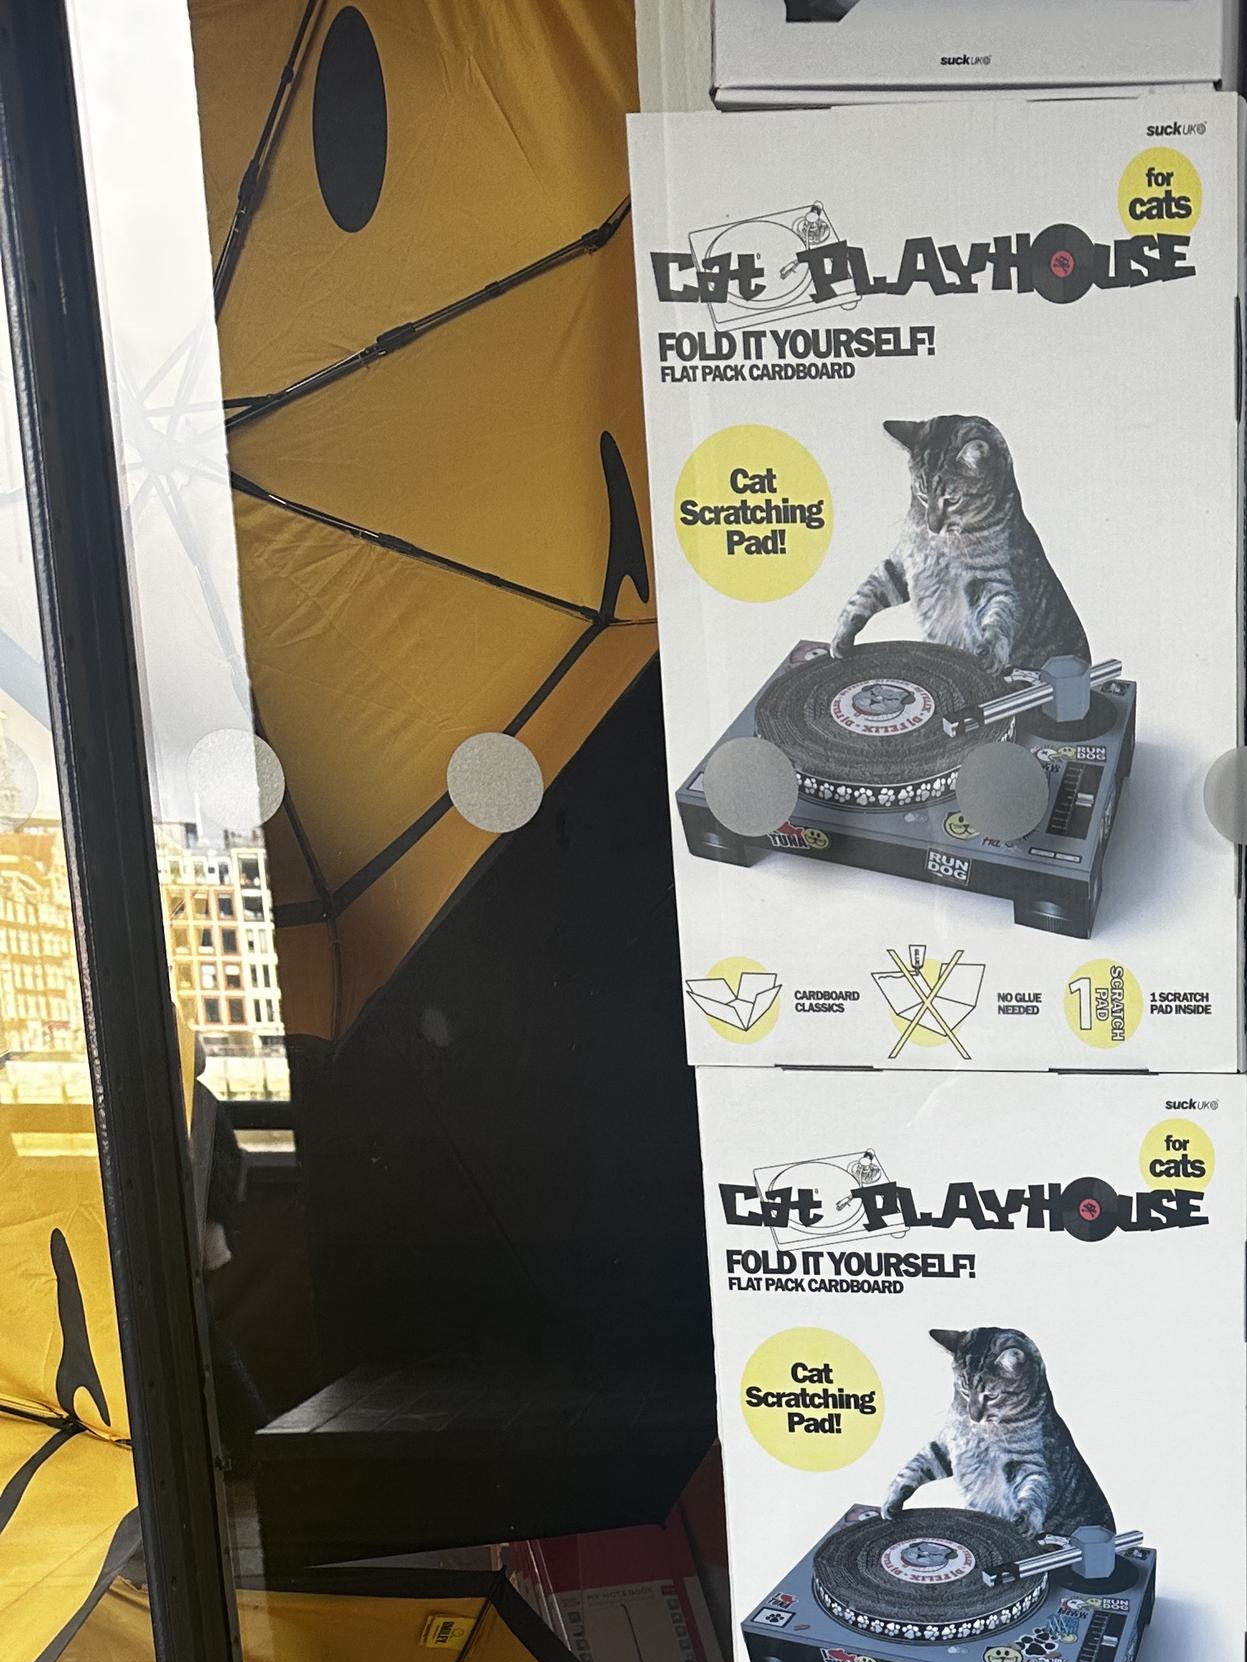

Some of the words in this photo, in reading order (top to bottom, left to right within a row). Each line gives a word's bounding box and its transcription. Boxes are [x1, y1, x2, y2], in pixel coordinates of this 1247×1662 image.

[1146, 167, 1174, 187] for
[1128, 192, 1192, 221] cats
[658, 330, 736, 362] FOLD
[743, 331, 771, 360] IT
[769, 326, 936, 360] YOURSELF!
[660, 365, 699, 383] FLAT
[701, 364, 747, 382] PACK
[749, 362, 856, 381] CARDBOARD
[730, 468, 776, 494] Cat
[680, 498, 825, 529] Scratching
[726, 530, 787, 555] Pad!
[927, 861, 967, 881] DOG
[929, 851, 968, 870] RUN
[794, 990, 860, 1002] CARDBOARD
[794, 1001, 845, 1013] CLASSICS
[997, 992, 1013, 1003] NO
[1015, 992, 1042, 1003] GLUE
[1068, 976, 1092, 1030] 1
[1095, 987, 1109, 1022] PAD
[1108, 965, 1126, 1041] SCRATCH
[1150, 993, 1156, 1003] 1
[1159, 992, 1209, 1003] SCRATCH
[997, 1004, 1039, 1015] NEEDED
[1150, 1004, 1173, 1015] PAD
[1175, 1004, 1212, 1015] INSIDE
[1164, 1135, 1189, 1152] for
[1149, 1154, 1206, 1178] cats
[726, 1249, 797, 1274] FOLD
[802, 1252, 824, 1275] IT
[830, 1253, 976, 1279] YOURSELF!
[728, 1277, 761, 1291] FLAT
[765, 1278, 804, 1292] PACK
[807, 1279, 904, 1294] CARDBOARD
[791, 1363, 833, 1385] Cat
[746, 1386, 876, 1415] Scratching
[788, 1412, 842, 1434] Pad!
